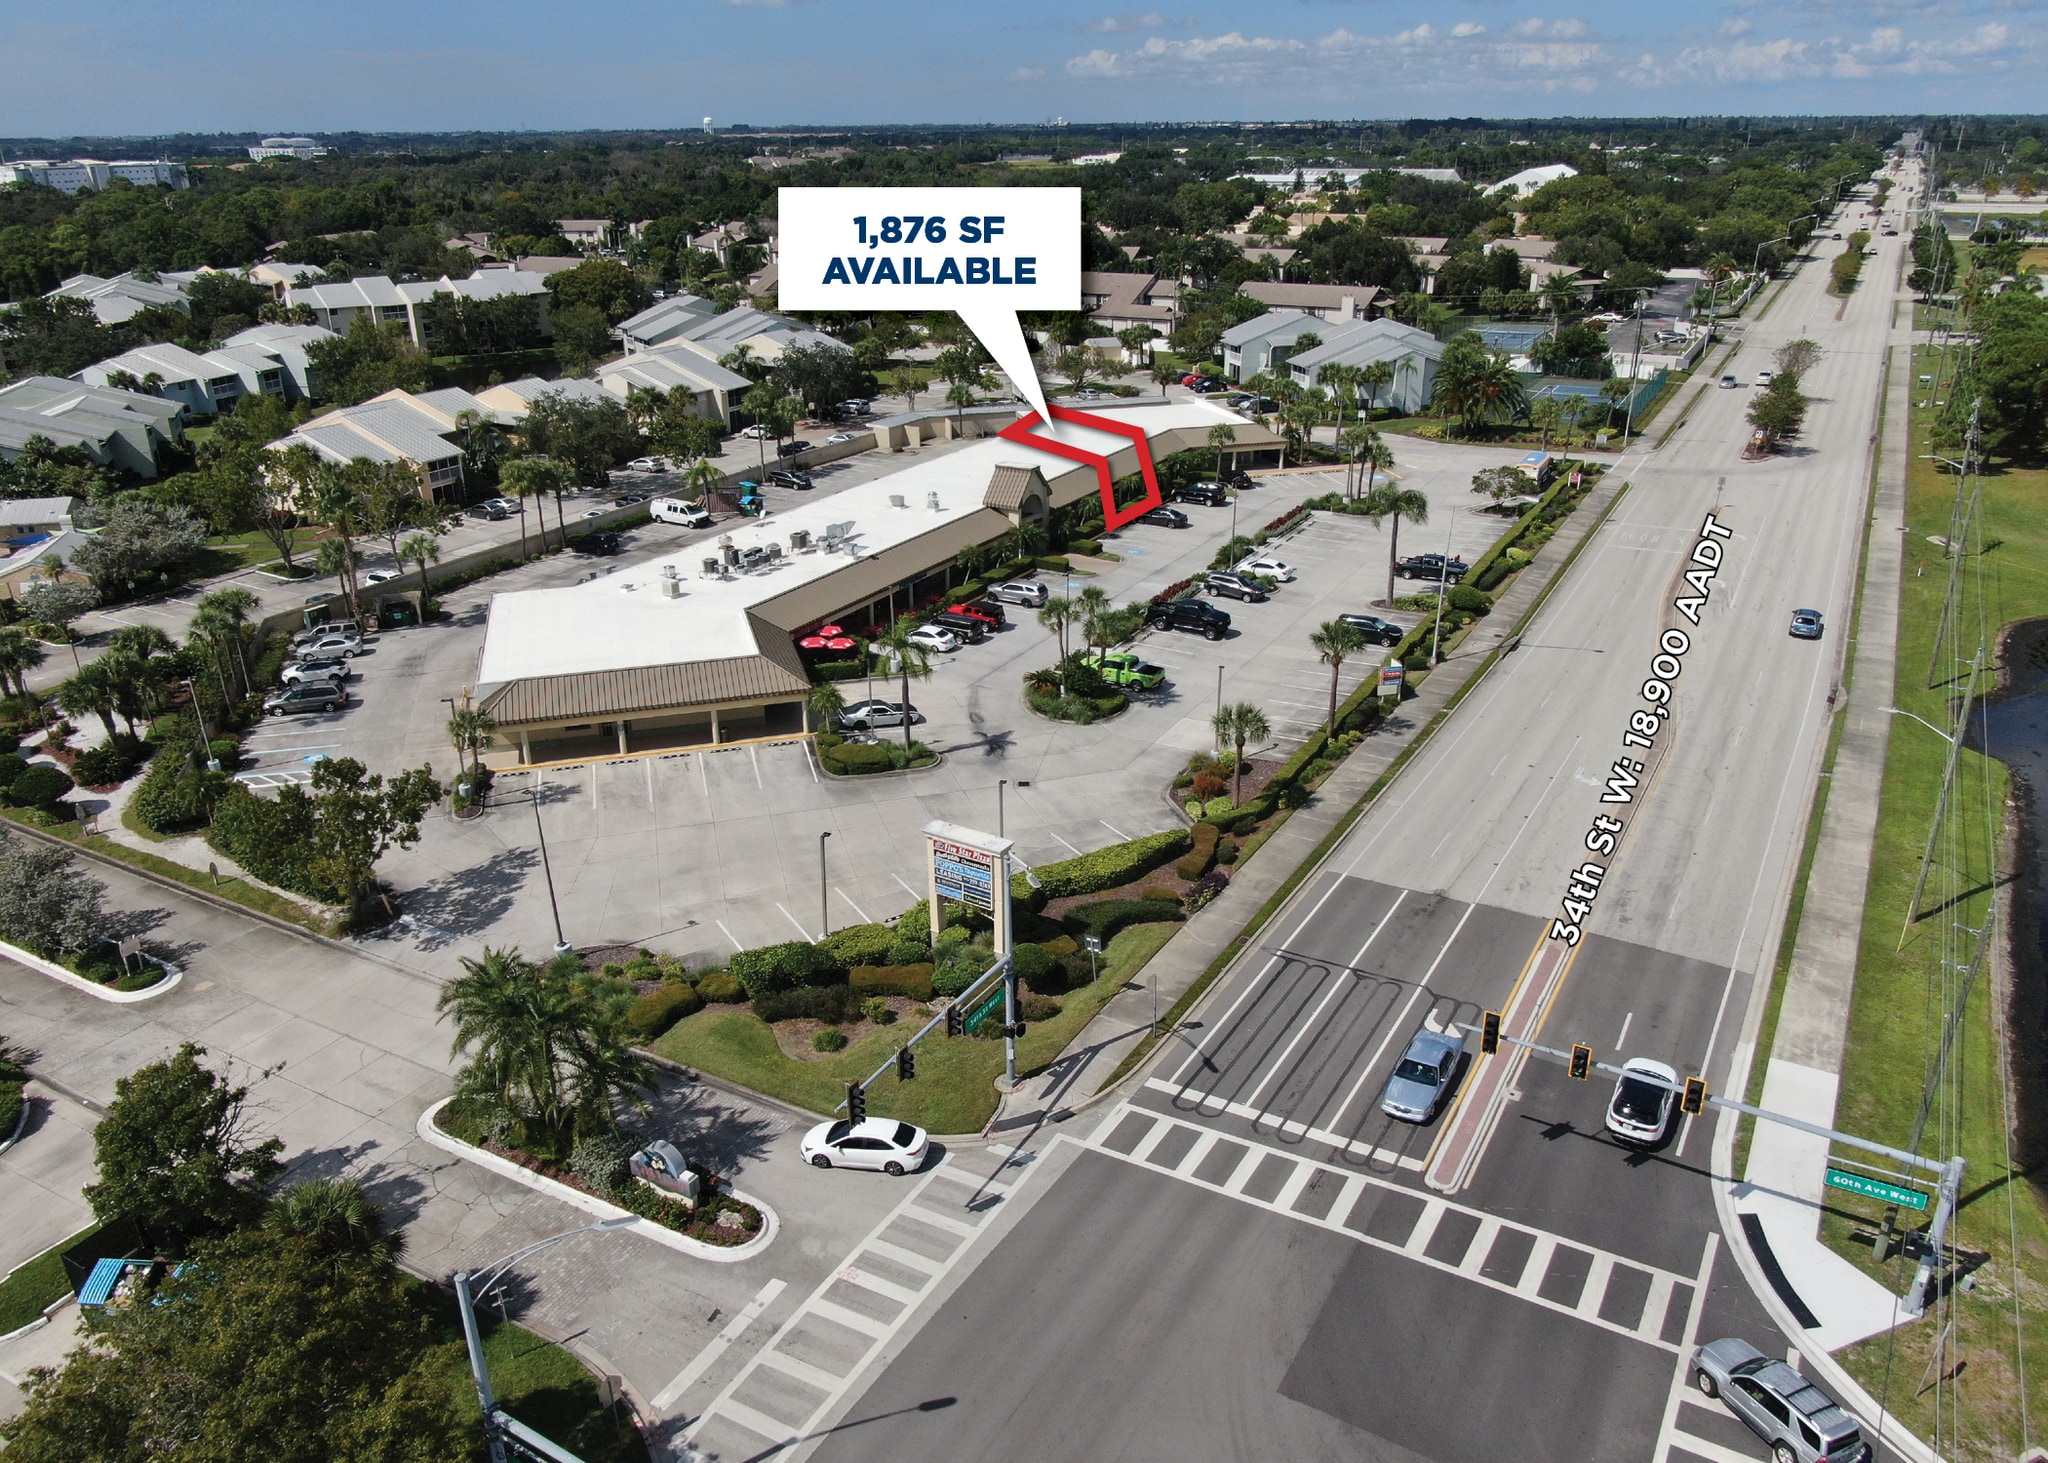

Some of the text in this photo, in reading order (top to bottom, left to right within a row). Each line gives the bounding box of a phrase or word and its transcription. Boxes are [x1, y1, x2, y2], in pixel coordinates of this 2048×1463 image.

[944, 843, 990, 862] Five Star Pizza
[936, 869, 963, 882] LEASING
[970, 1013, 982, 1026] 34th
[982, 1007, 989, 1015] St
[1833, 1175, 1919, 1204] 60th Ave West
